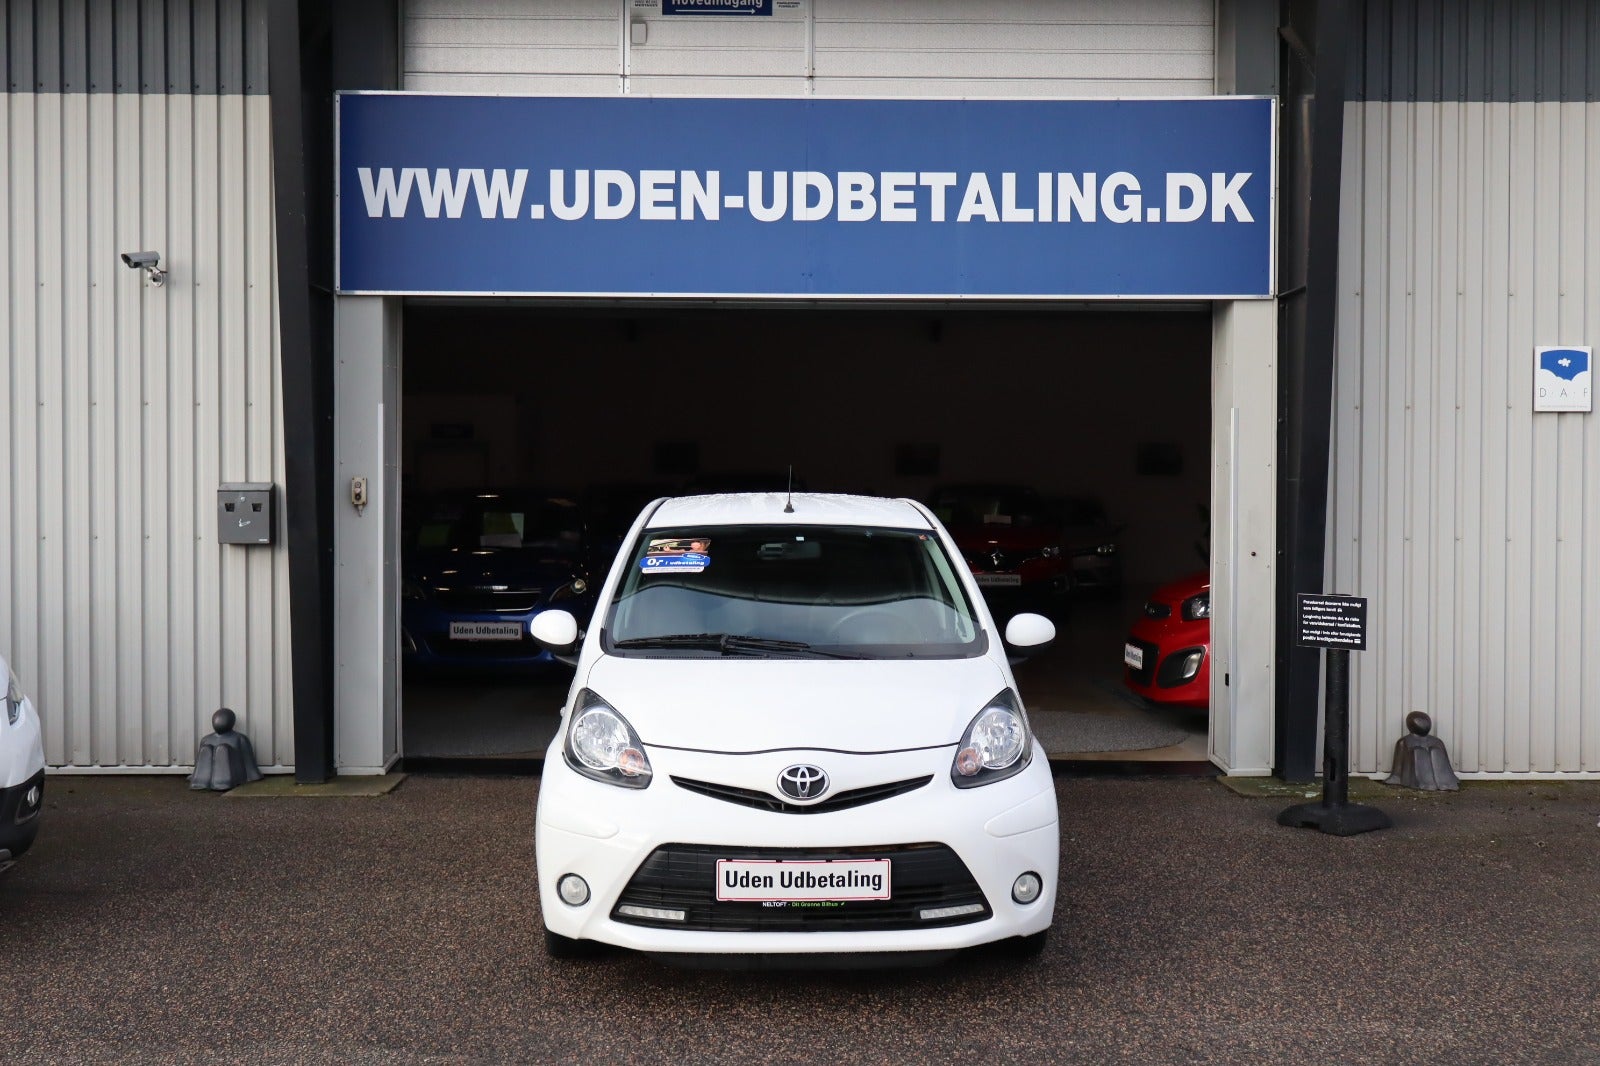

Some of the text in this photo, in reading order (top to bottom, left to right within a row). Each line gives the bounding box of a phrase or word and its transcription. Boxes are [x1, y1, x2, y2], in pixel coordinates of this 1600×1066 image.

[357, 167, 1255, 224] WWW.UDEN-UDBETALING.DK
[453, 626, 519, 637] Uden Udbetaling
[725, 870, 882, 891] Uden Udbetaling
